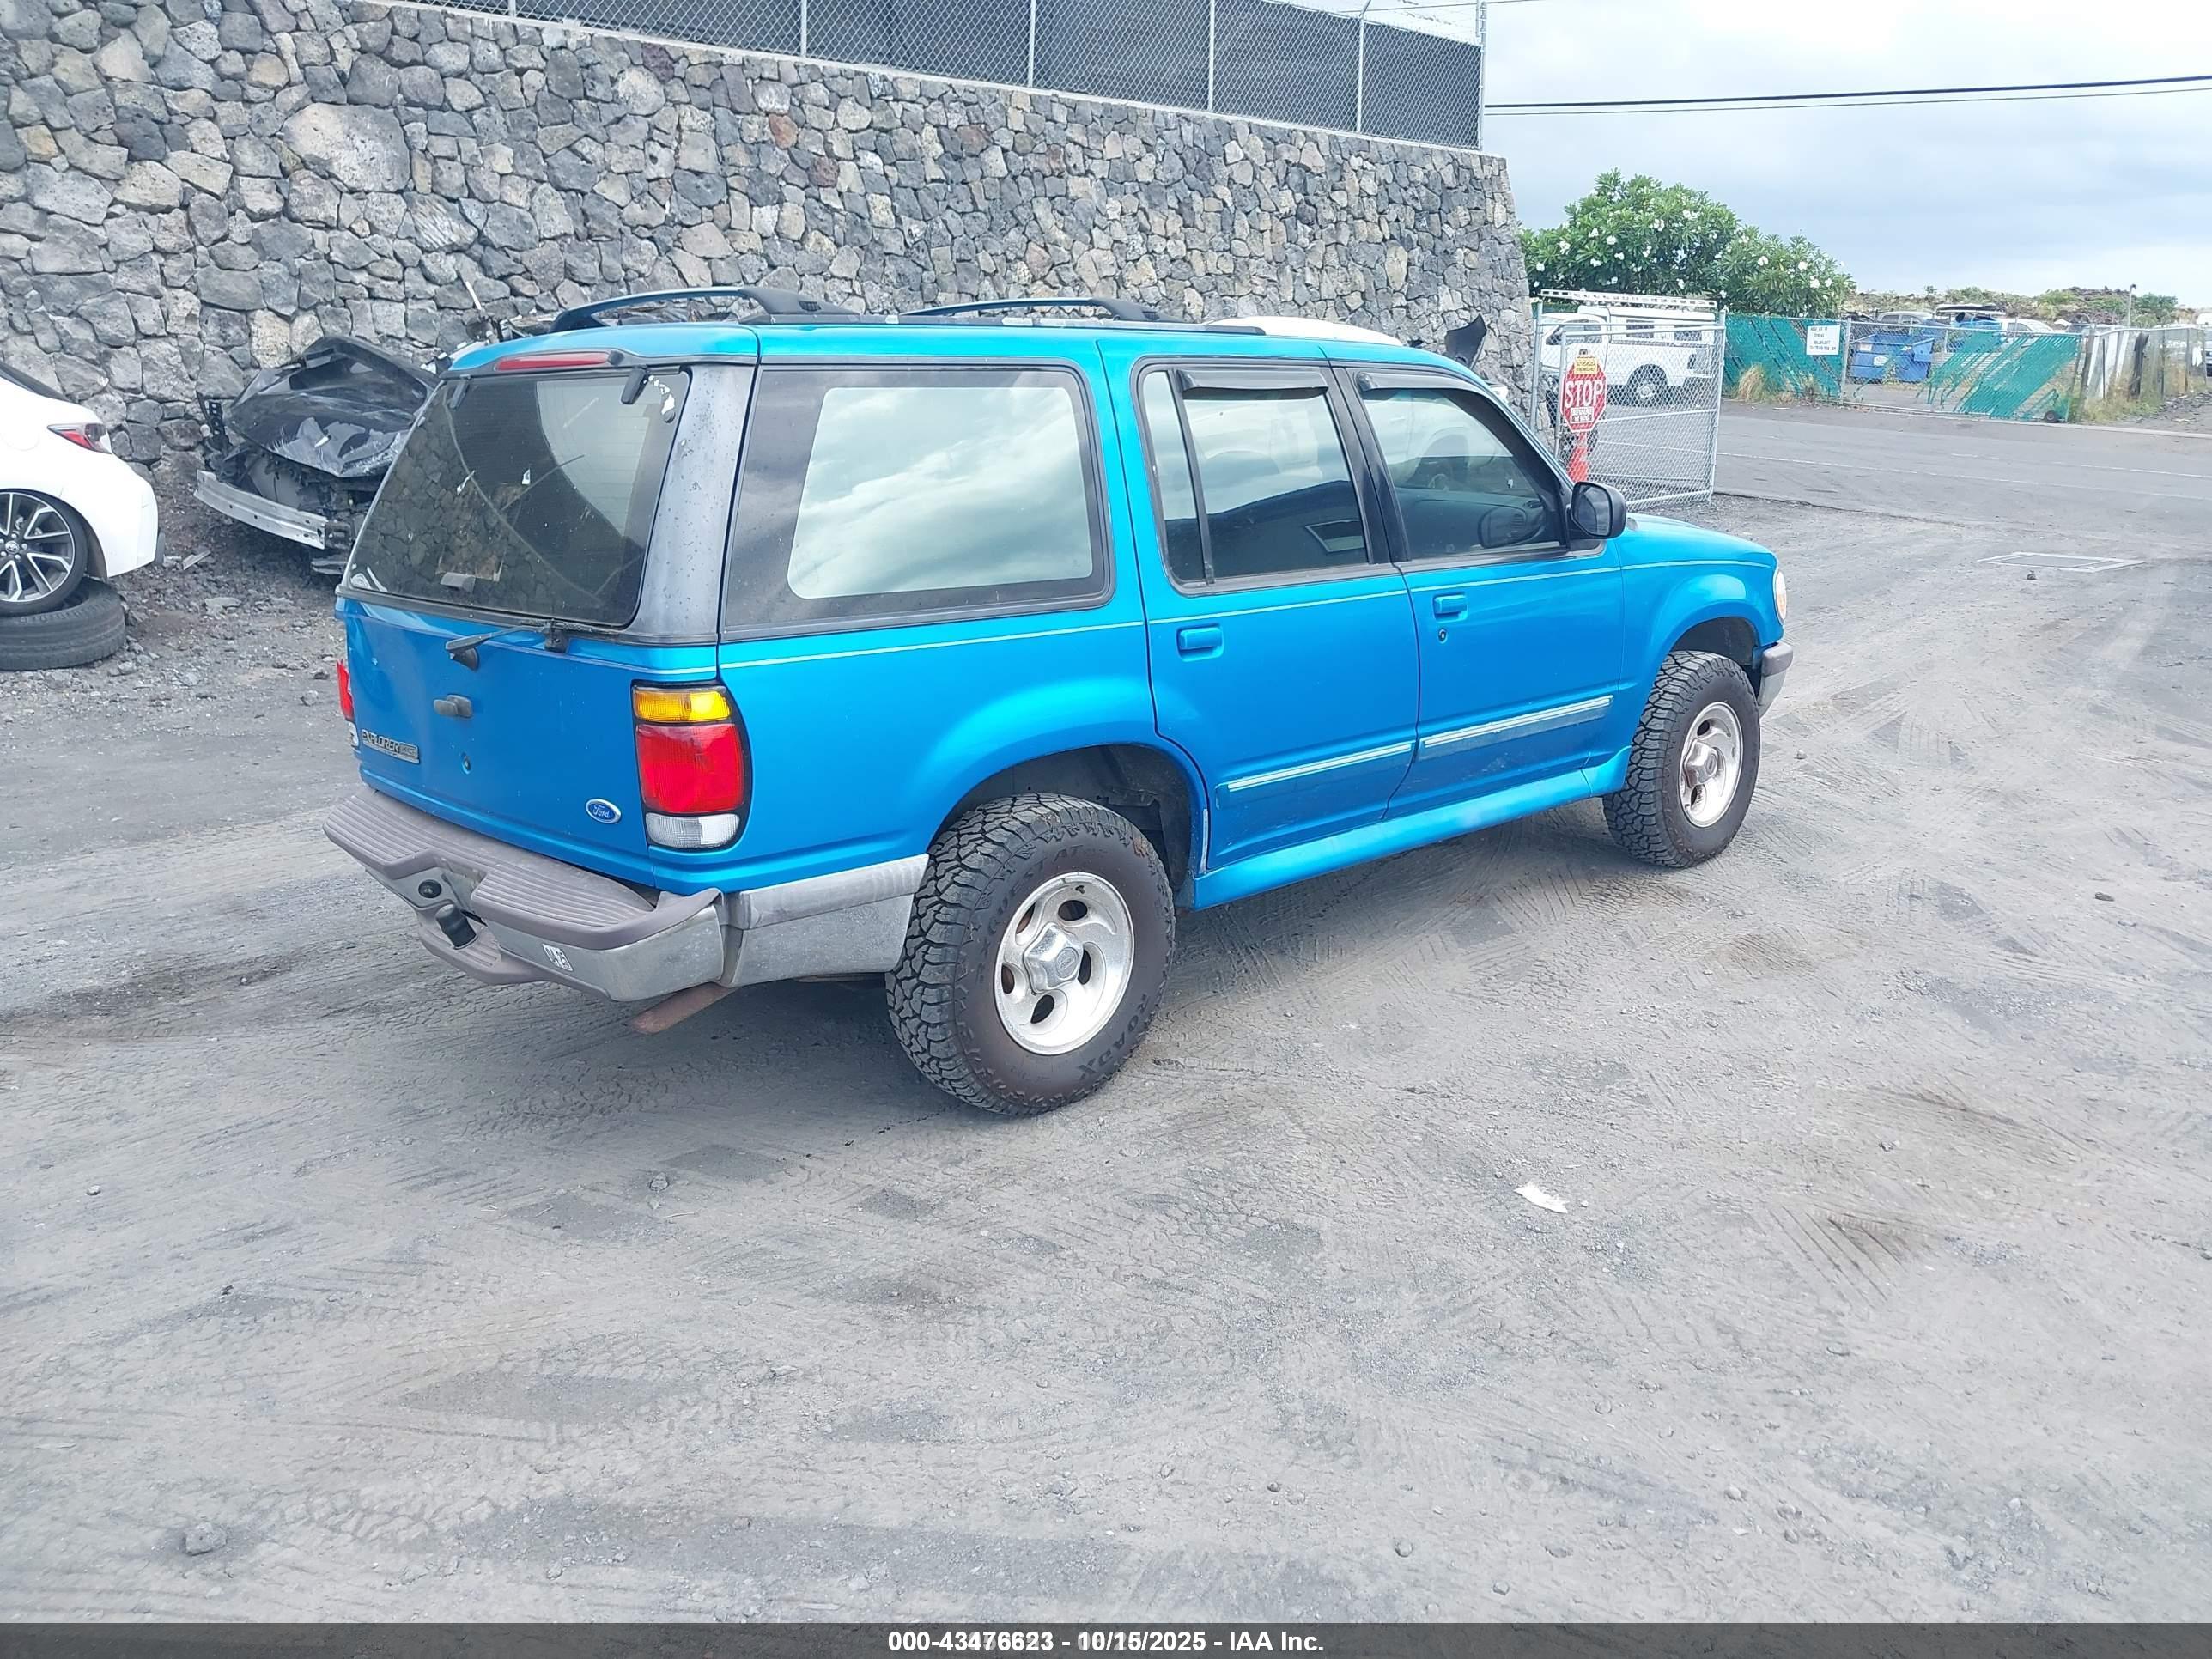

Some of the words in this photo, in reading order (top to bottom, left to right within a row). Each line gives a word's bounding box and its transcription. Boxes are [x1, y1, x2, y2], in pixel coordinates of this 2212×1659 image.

[1565, 380, 1603, 408] STOP
[362, 729, 400, 753] EXPLORER
[1077, 993, 1151, 1081] ROADX
